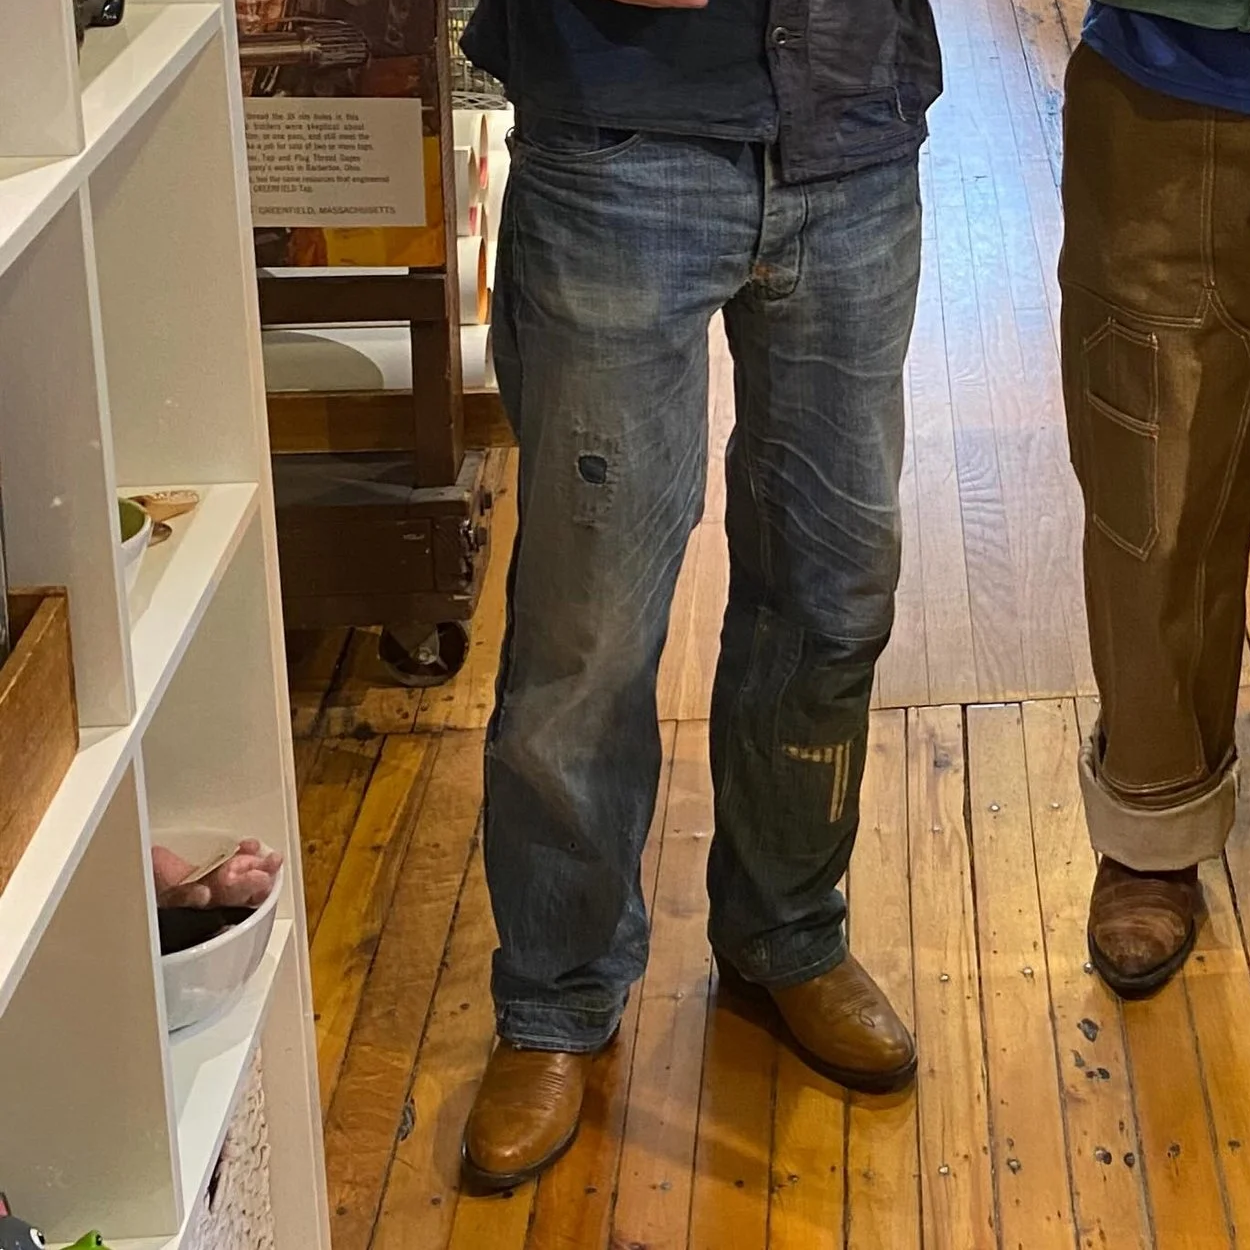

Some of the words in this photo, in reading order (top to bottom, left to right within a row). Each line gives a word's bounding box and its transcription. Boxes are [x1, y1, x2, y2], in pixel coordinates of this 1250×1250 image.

[346, 113, 360, 121] this
[307, 122, 340, 131] skeptical
[343, 122, 365, 130] about
[324, 132, 336, 140] still
[278, 153, 291, 161] and
[294, 152, 310, 163] Plug
[336, 175, 351, 183] that
[351, 176, 390, 184] engineered
[318, 205, 396, 216] MASSACHUSETTS
